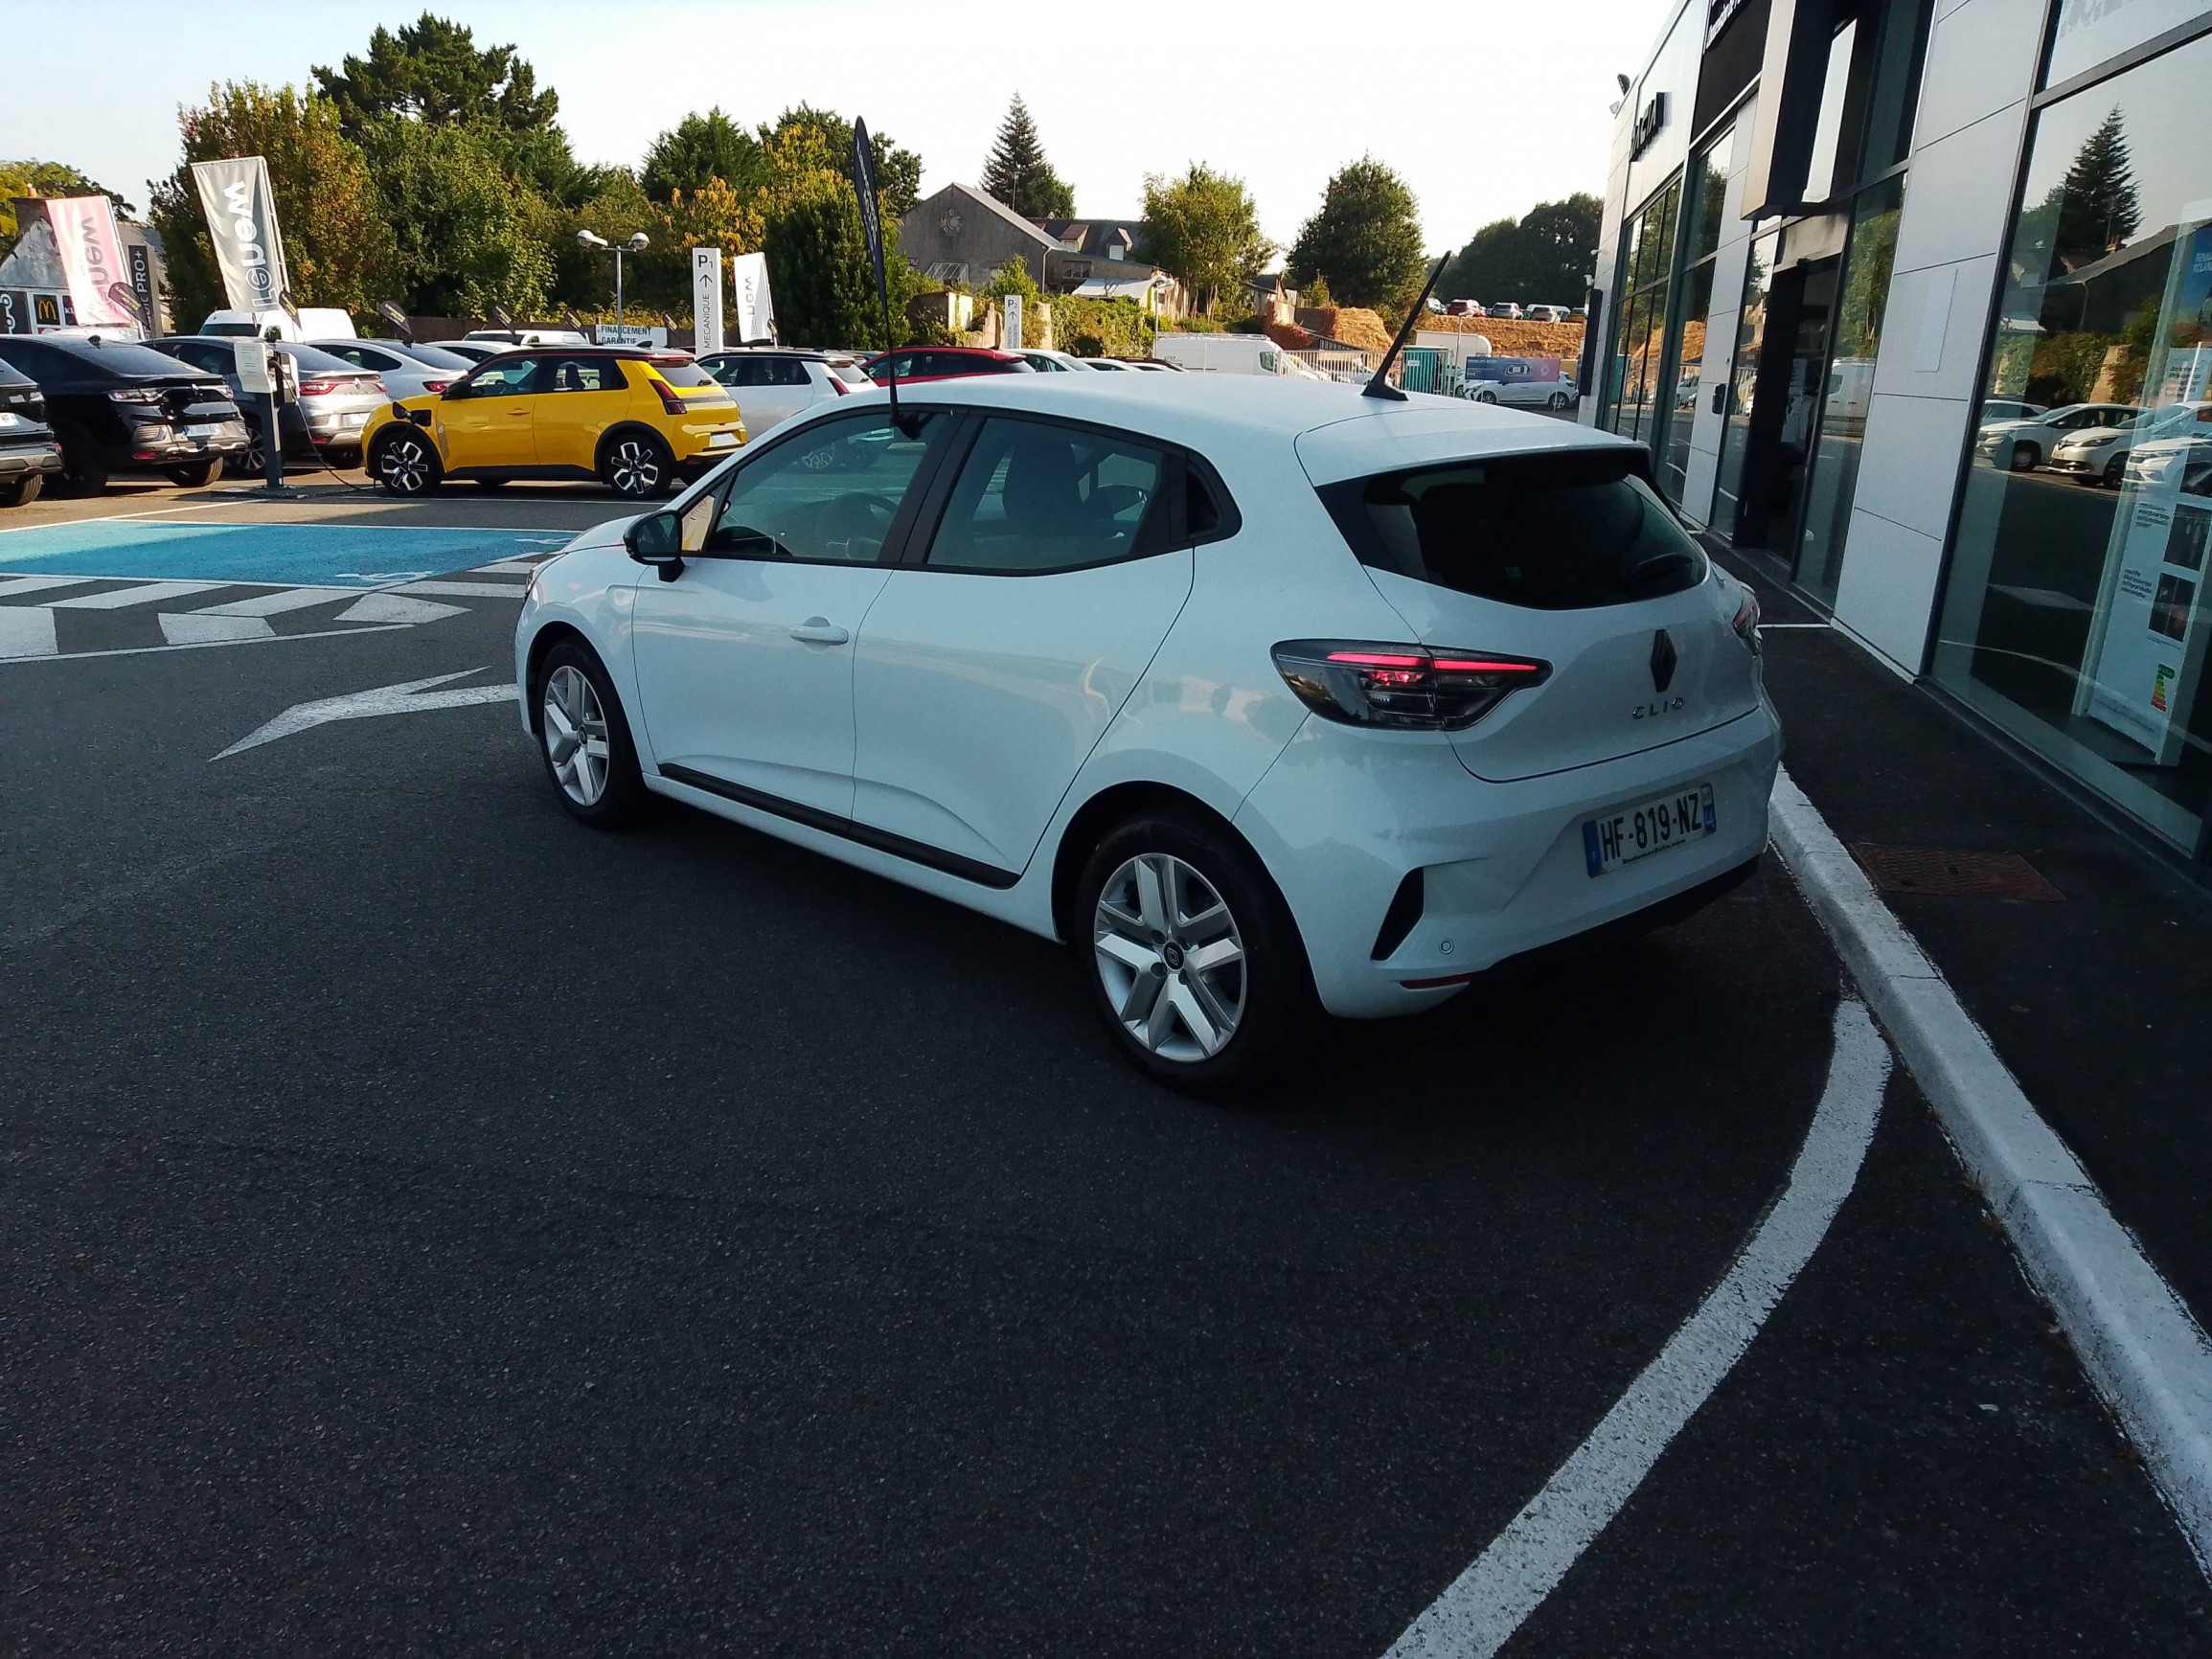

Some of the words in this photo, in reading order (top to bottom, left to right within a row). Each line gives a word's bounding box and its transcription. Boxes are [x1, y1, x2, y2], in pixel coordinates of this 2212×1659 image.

[134, 250, 148, 293] PRO+
[697, 255, 714, 268] P1
[601, 326, 651, 335] FINACEMENT
[702, 293, 711, 349] MECANIQUE
[1631, 696, 1684, 719] CLIO
[1600, 792, 1702, 862] HF-819-NZ
